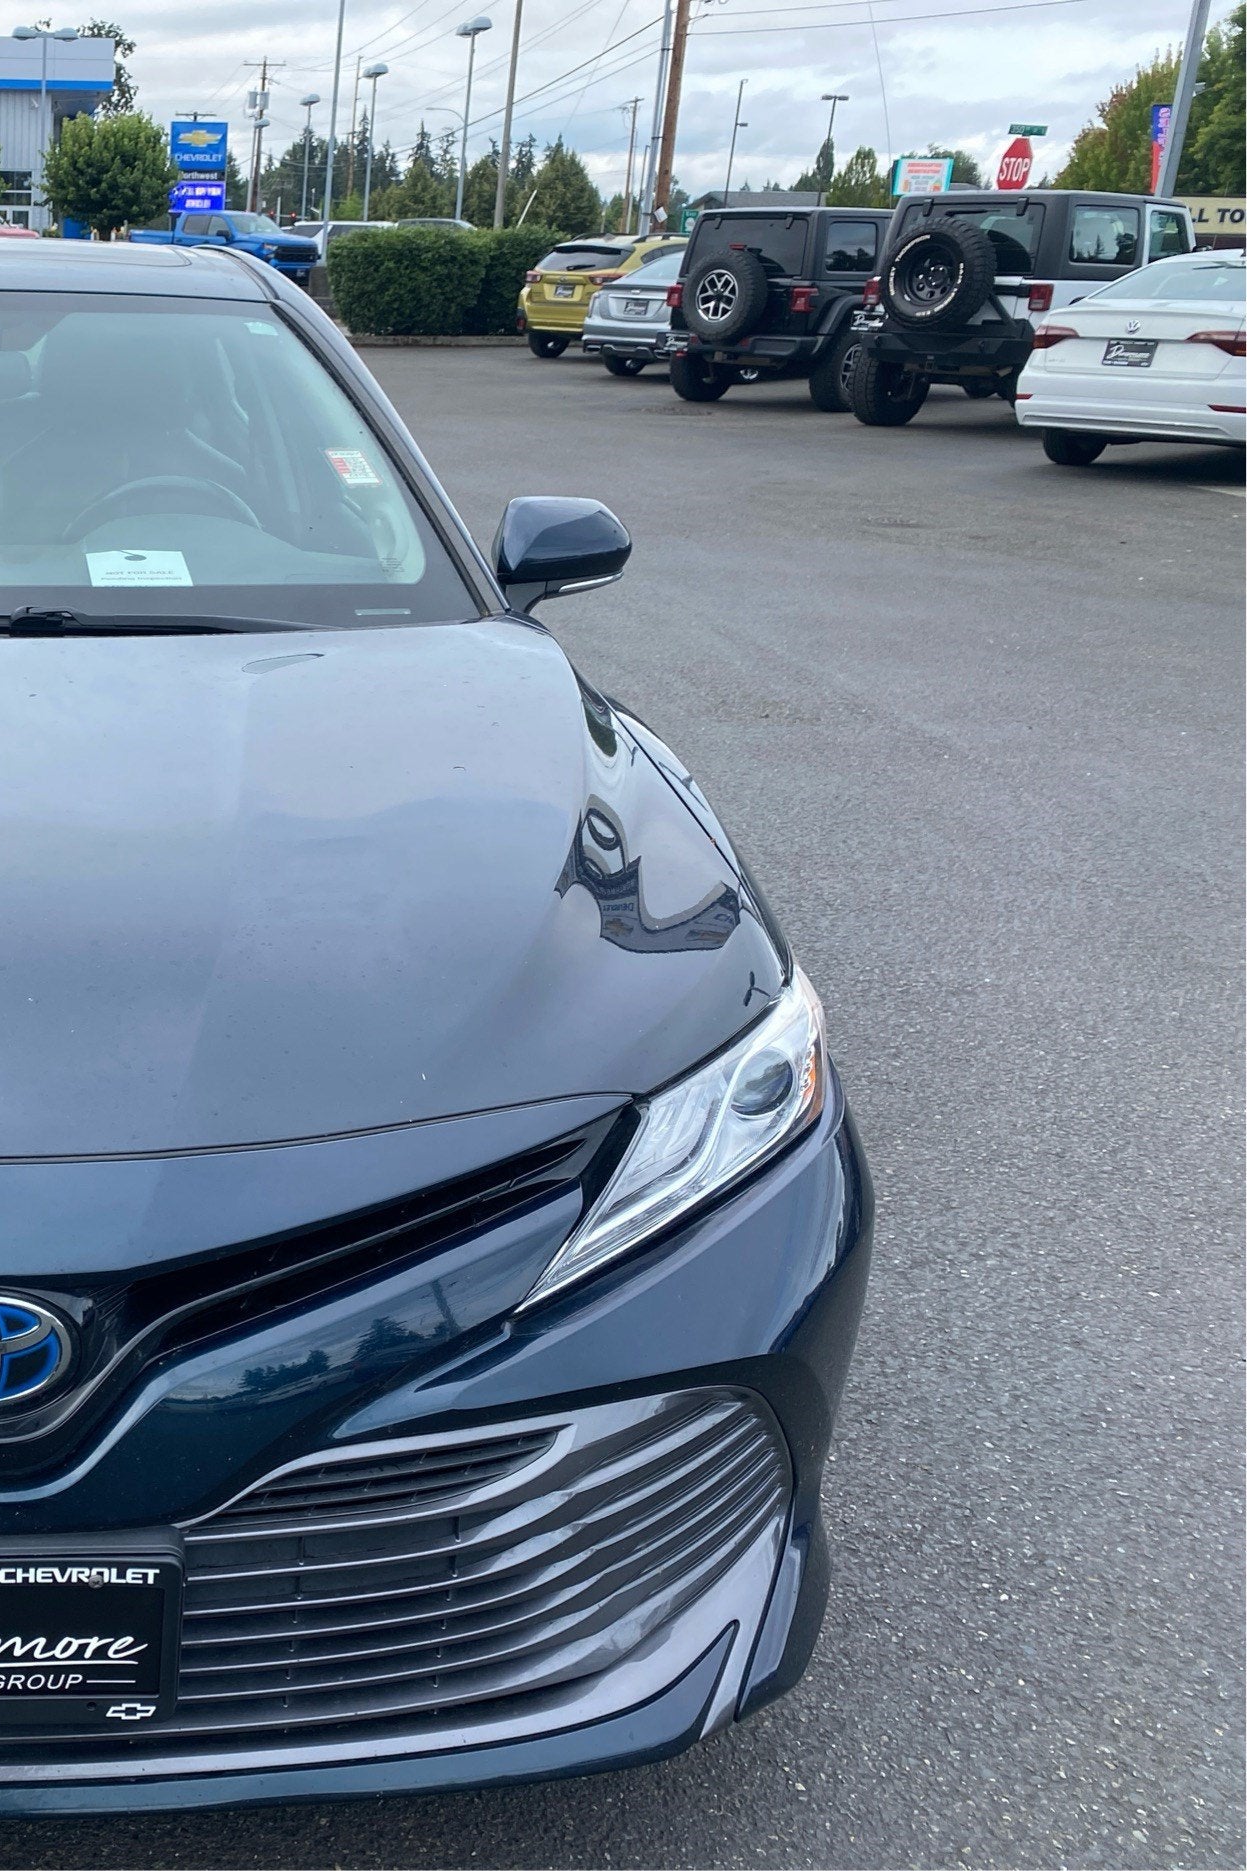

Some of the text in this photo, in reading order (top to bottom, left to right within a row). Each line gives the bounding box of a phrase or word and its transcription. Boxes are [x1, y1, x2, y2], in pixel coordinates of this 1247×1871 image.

[174, 153, 223, 162] CHEVROLET
[999, 157, 1030, 181] STOP
[180, 171, 218, 180] orthwest
